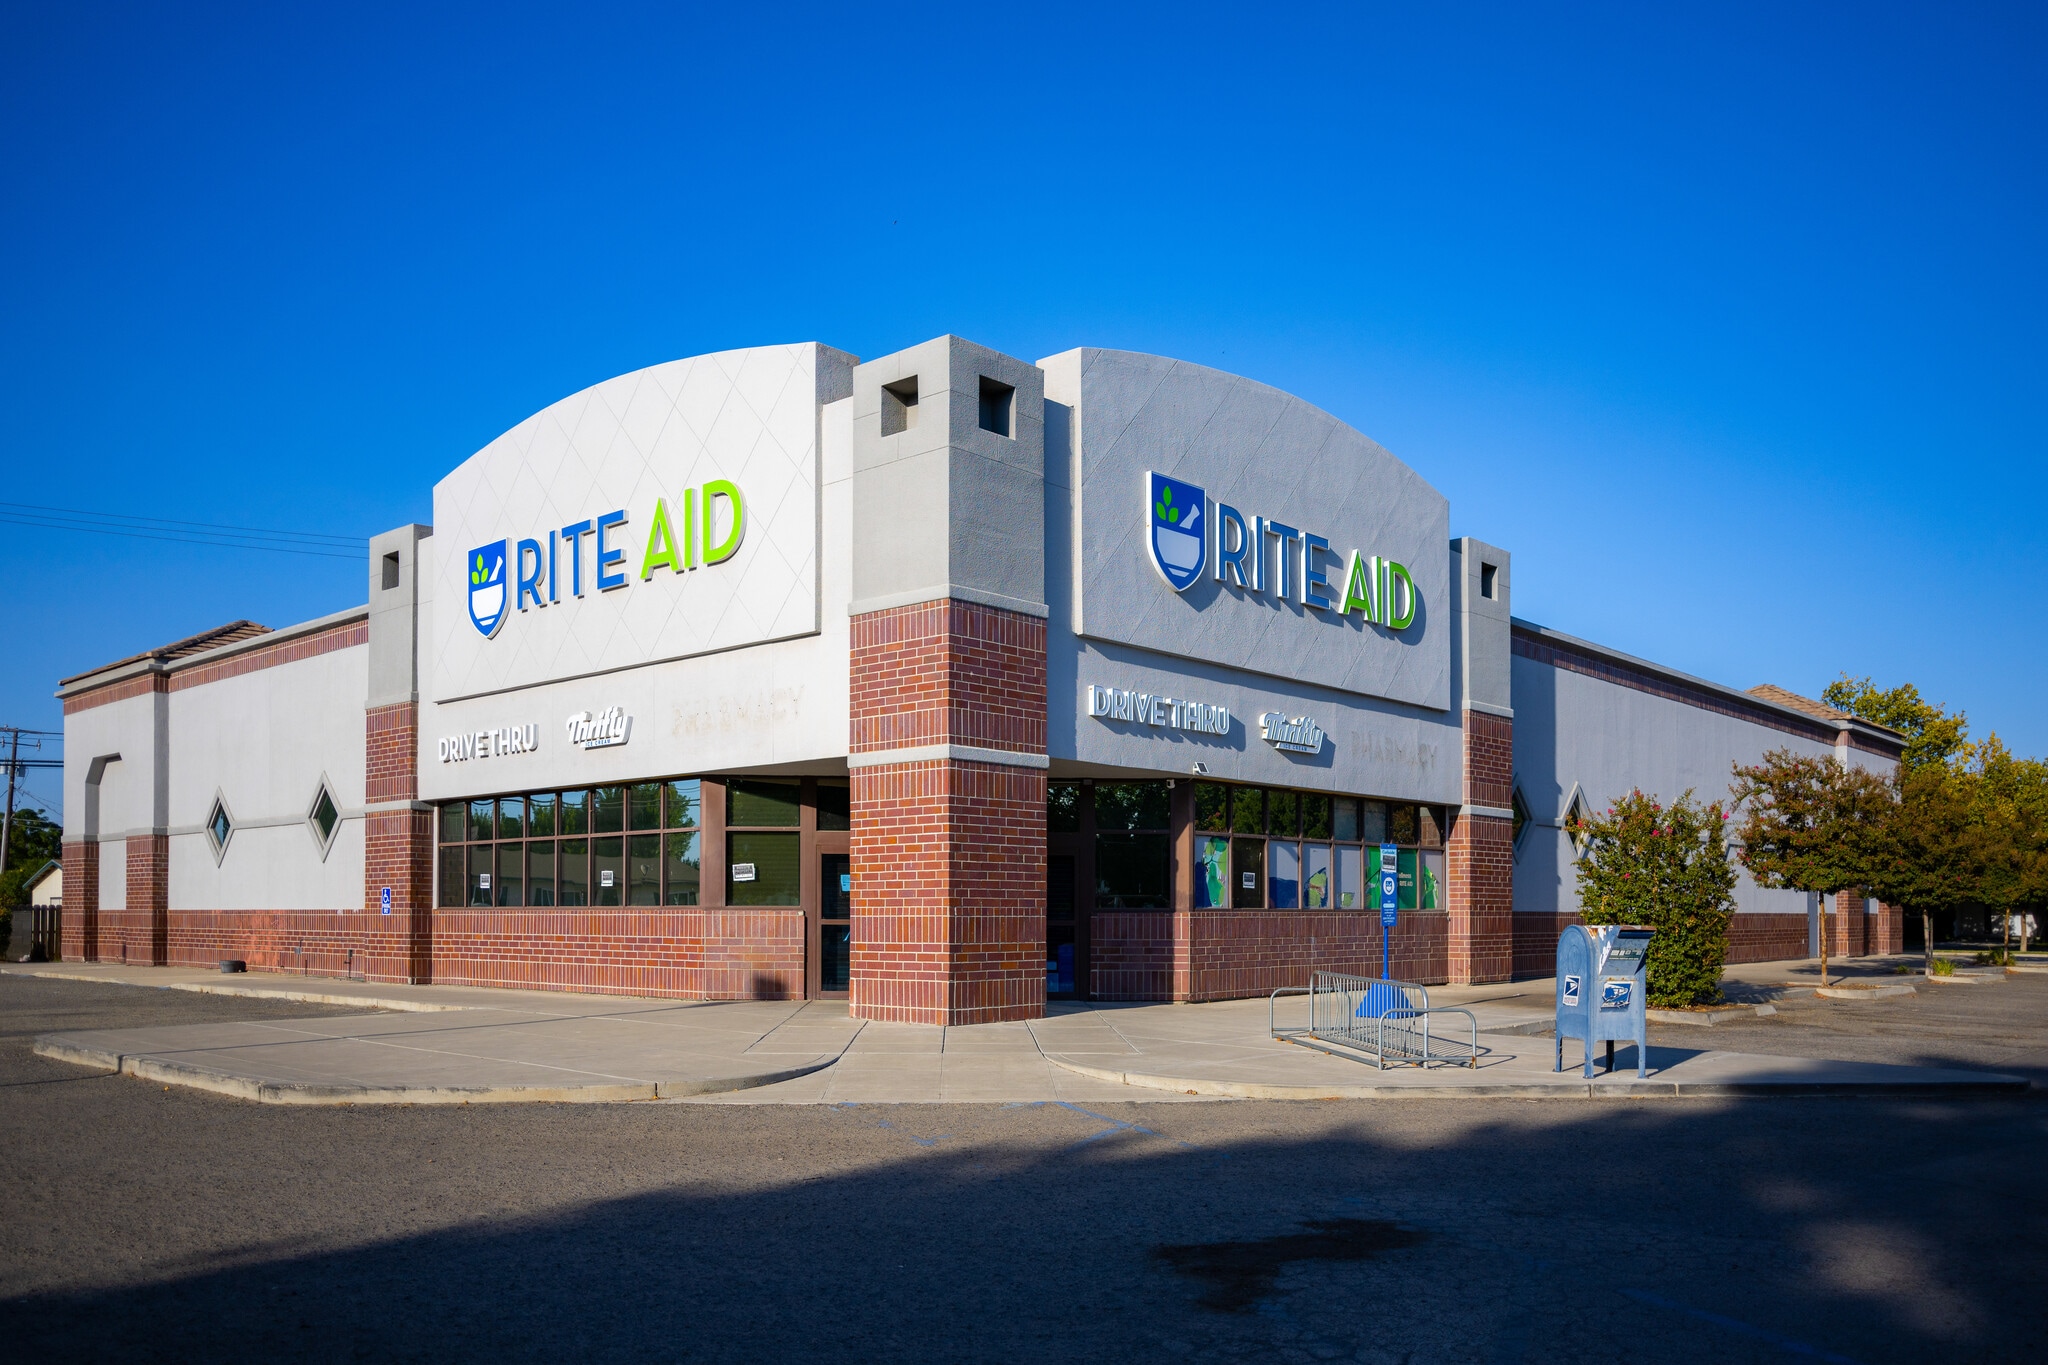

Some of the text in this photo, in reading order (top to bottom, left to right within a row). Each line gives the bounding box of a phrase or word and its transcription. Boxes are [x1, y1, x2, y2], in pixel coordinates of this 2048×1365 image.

[517, 479, 747, 611] RITE AID
[1214, 502, 1416, 630] RITE AID
[566, 706, 633, 747] Thrifty
[1088, 684, 1230, 735] DRIVE THRU
[1259, 712, 1323, 753] Thrifty
[439, 724, 538, 762] DRIVE THRU
